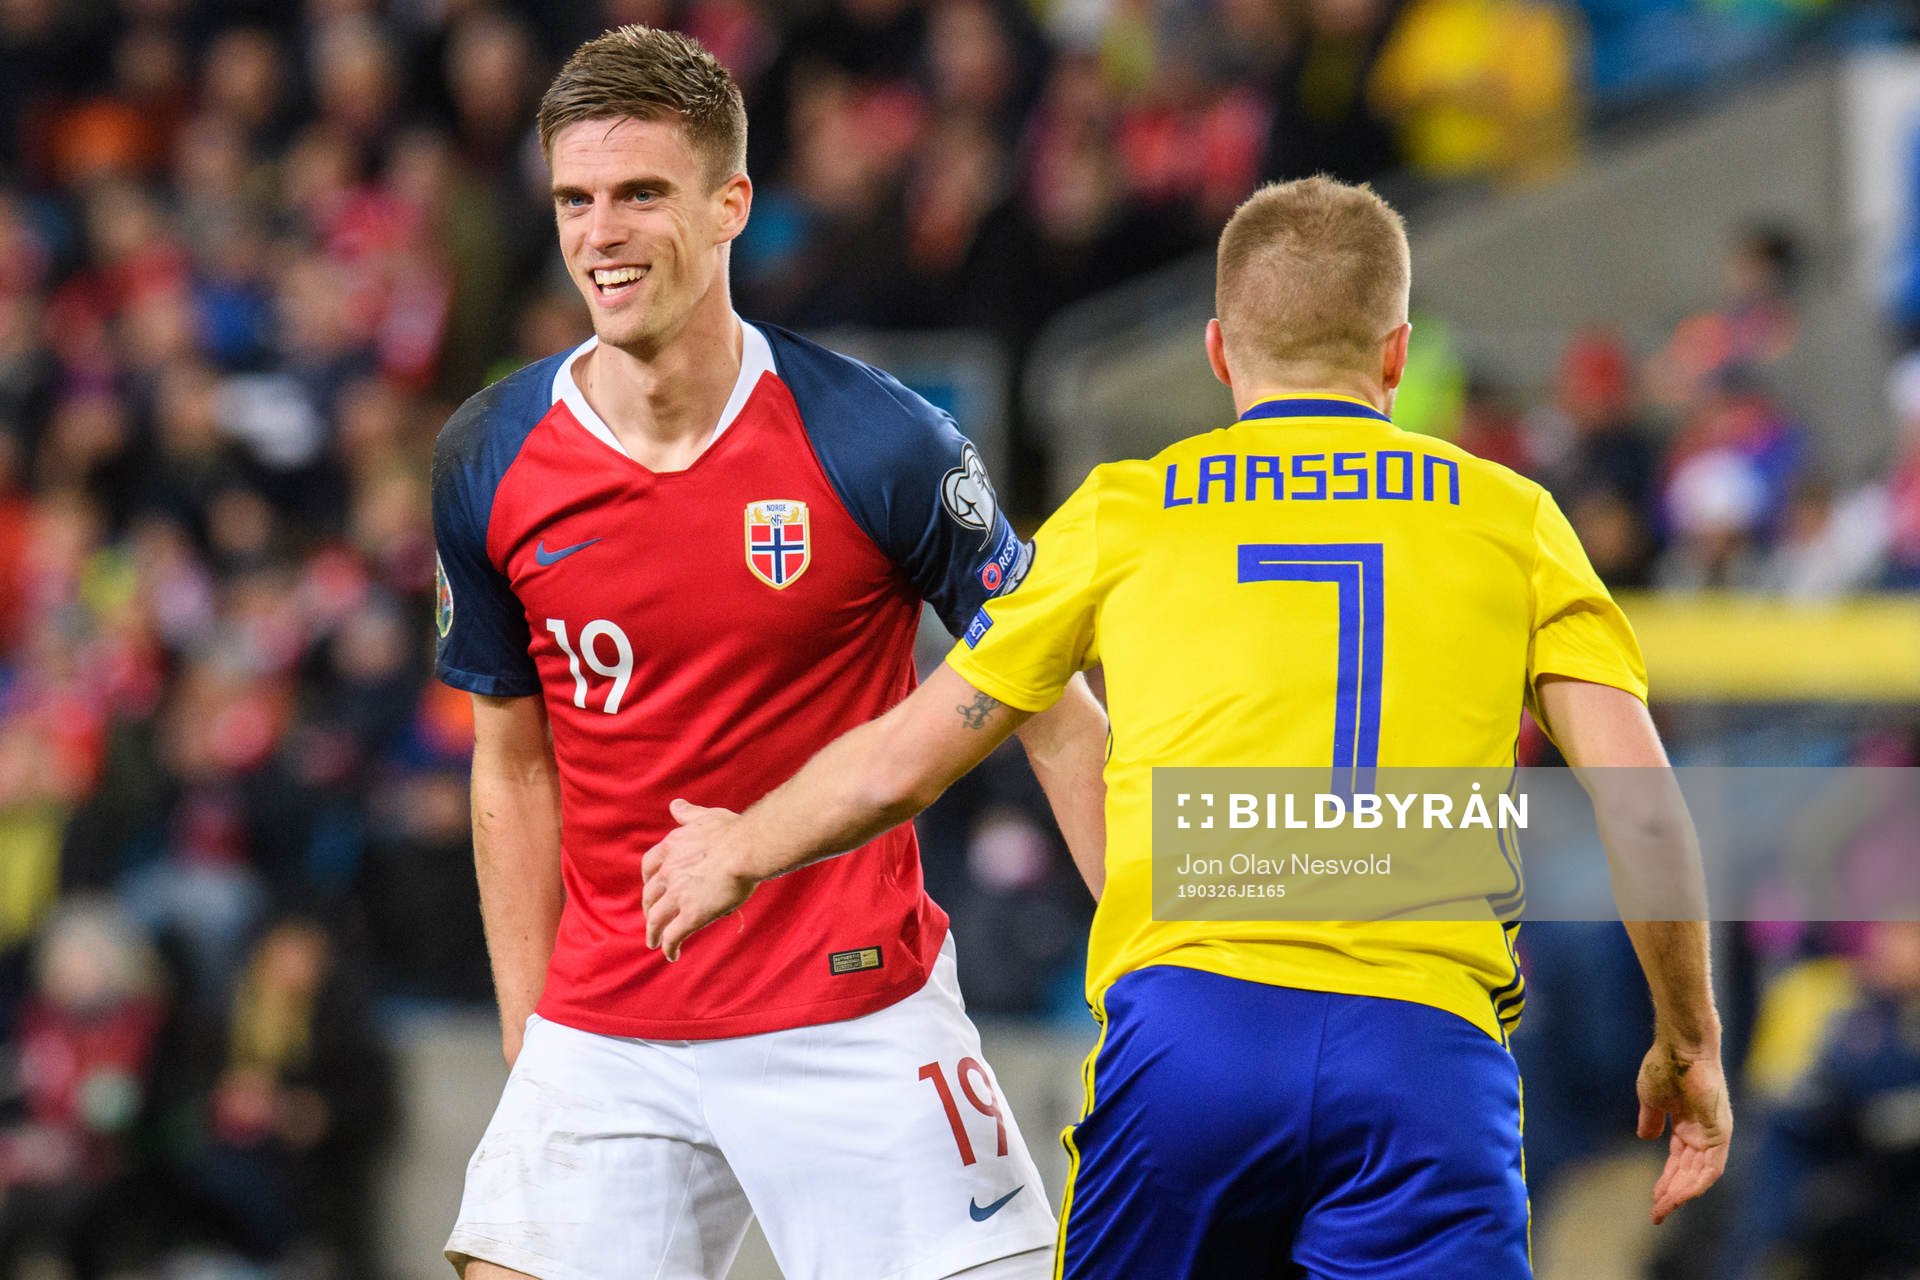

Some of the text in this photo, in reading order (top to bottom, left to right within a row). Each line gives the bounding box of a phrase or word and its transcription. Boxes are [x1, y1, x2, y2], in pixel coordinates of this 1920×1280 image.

[766, 504, 786, 512] NORGE
[1164, 451, 1460, 509] LARSSON
[546, 618, 634, 714] 19
[1237, 543, 1385, 815] 7
[918, 1056, 1009, 1167] 19
